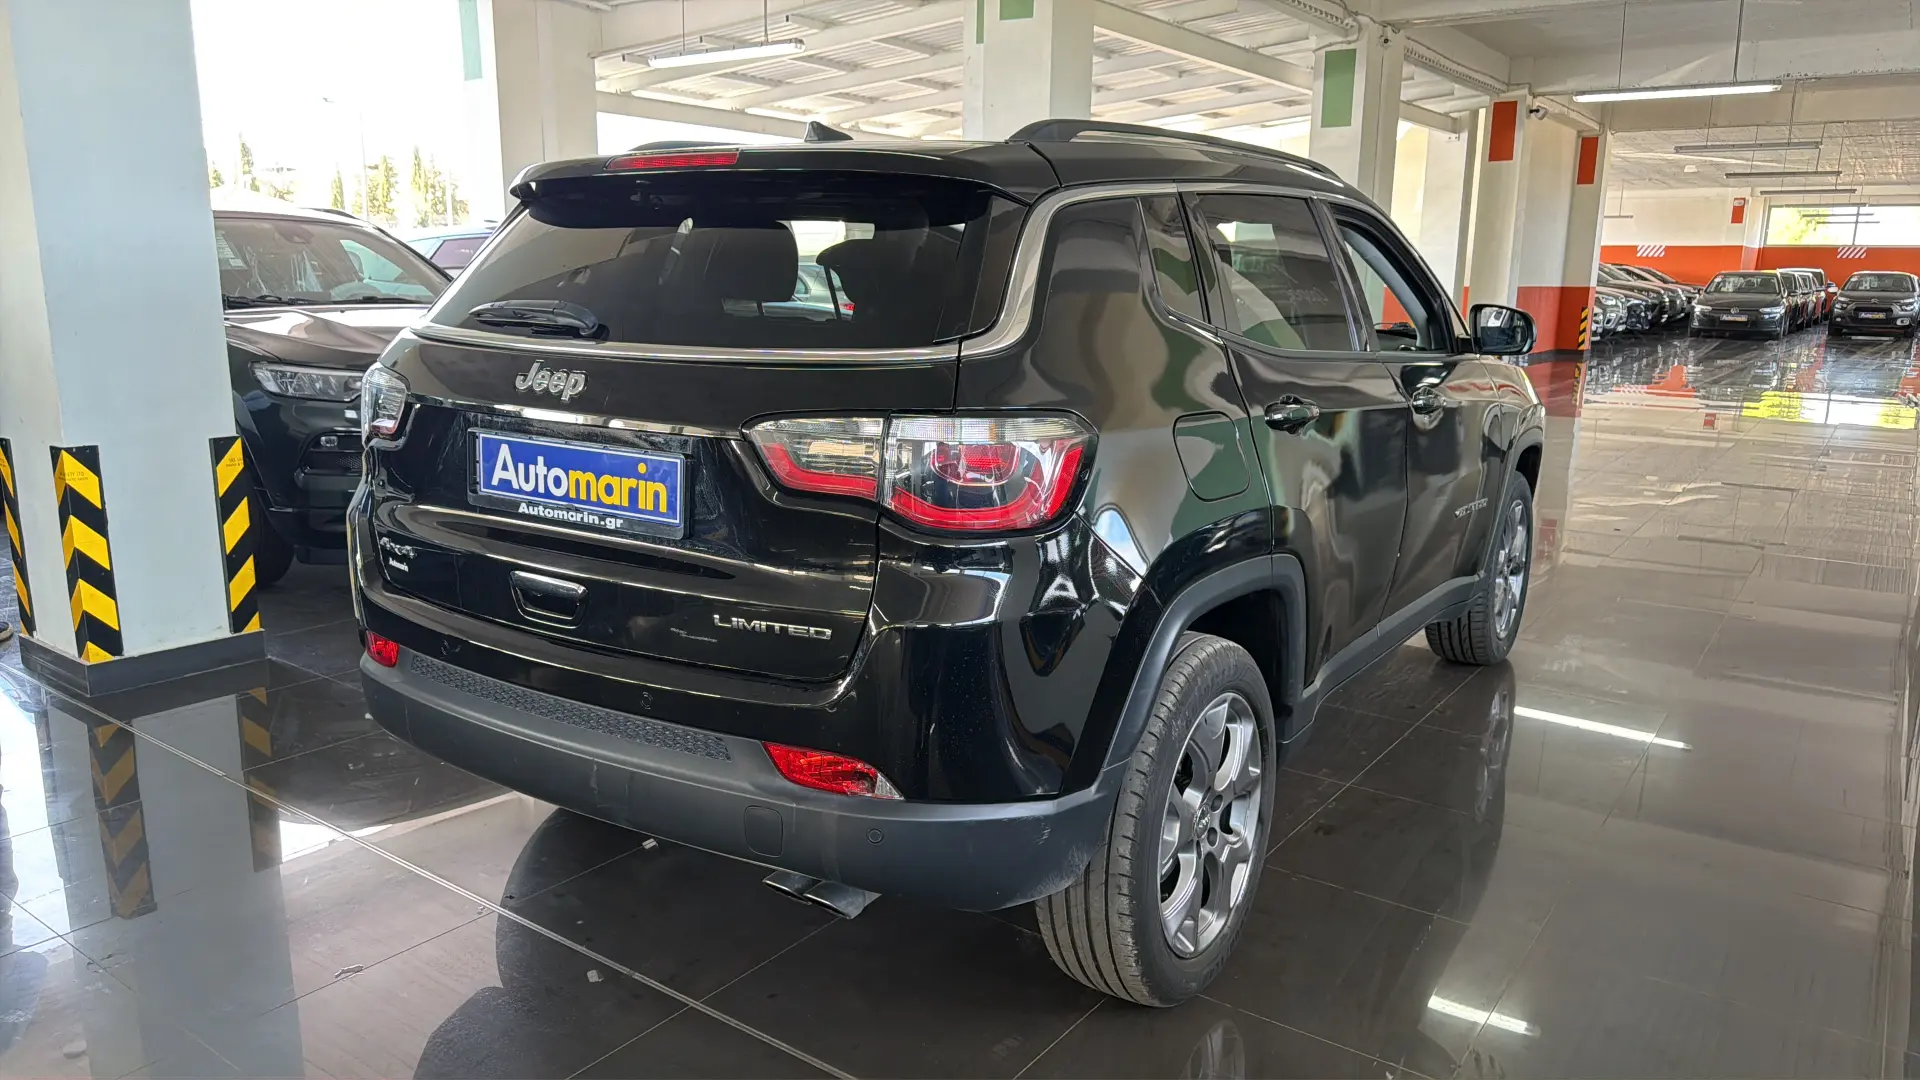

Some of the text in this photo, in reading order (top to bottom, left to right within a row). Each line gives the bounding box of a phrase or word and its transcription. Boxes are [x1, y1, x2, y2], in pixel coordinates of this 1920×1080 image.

[515, 359, 588, 402] Jeep
[491, 443, 667, 513] Automarin
[518, 502, 624, 529] Automarin.gr
[713, 614, 833, 640] LIMITED
